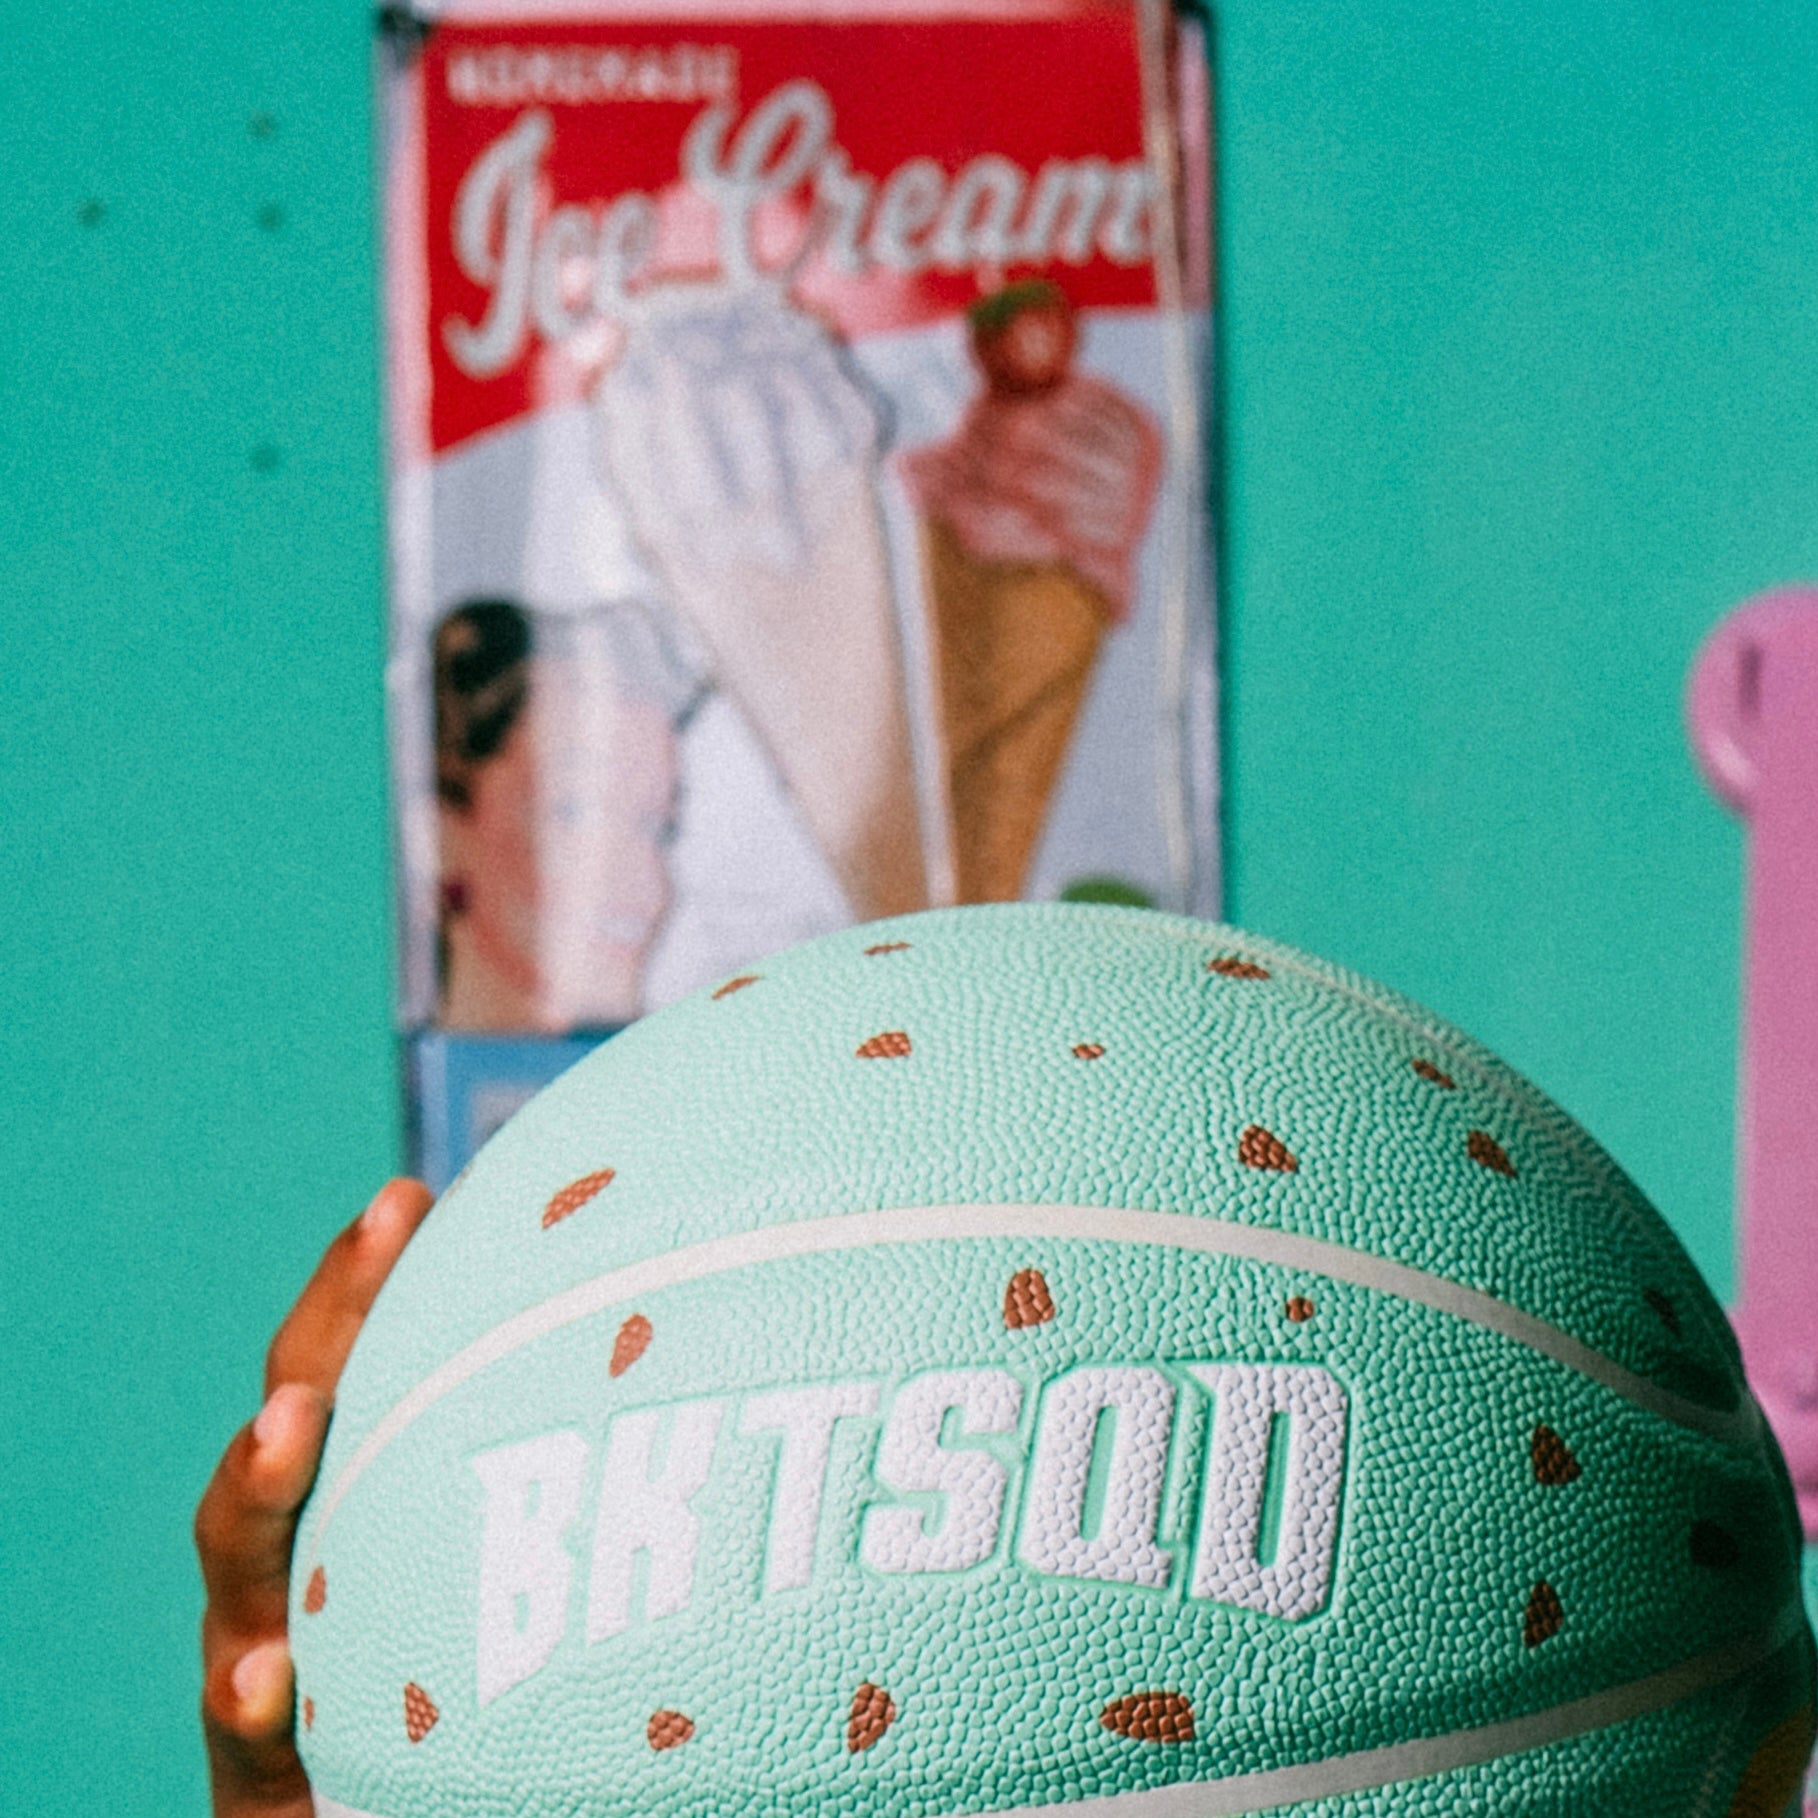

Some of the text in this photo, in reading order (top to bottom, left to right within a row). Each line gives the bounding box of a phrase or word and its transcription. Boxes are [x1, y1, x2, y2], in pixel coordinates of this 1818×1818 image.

[443, 78, 1158, 374] Ice Cream
[472, 1362, 1348, 1706] BKTSQD
